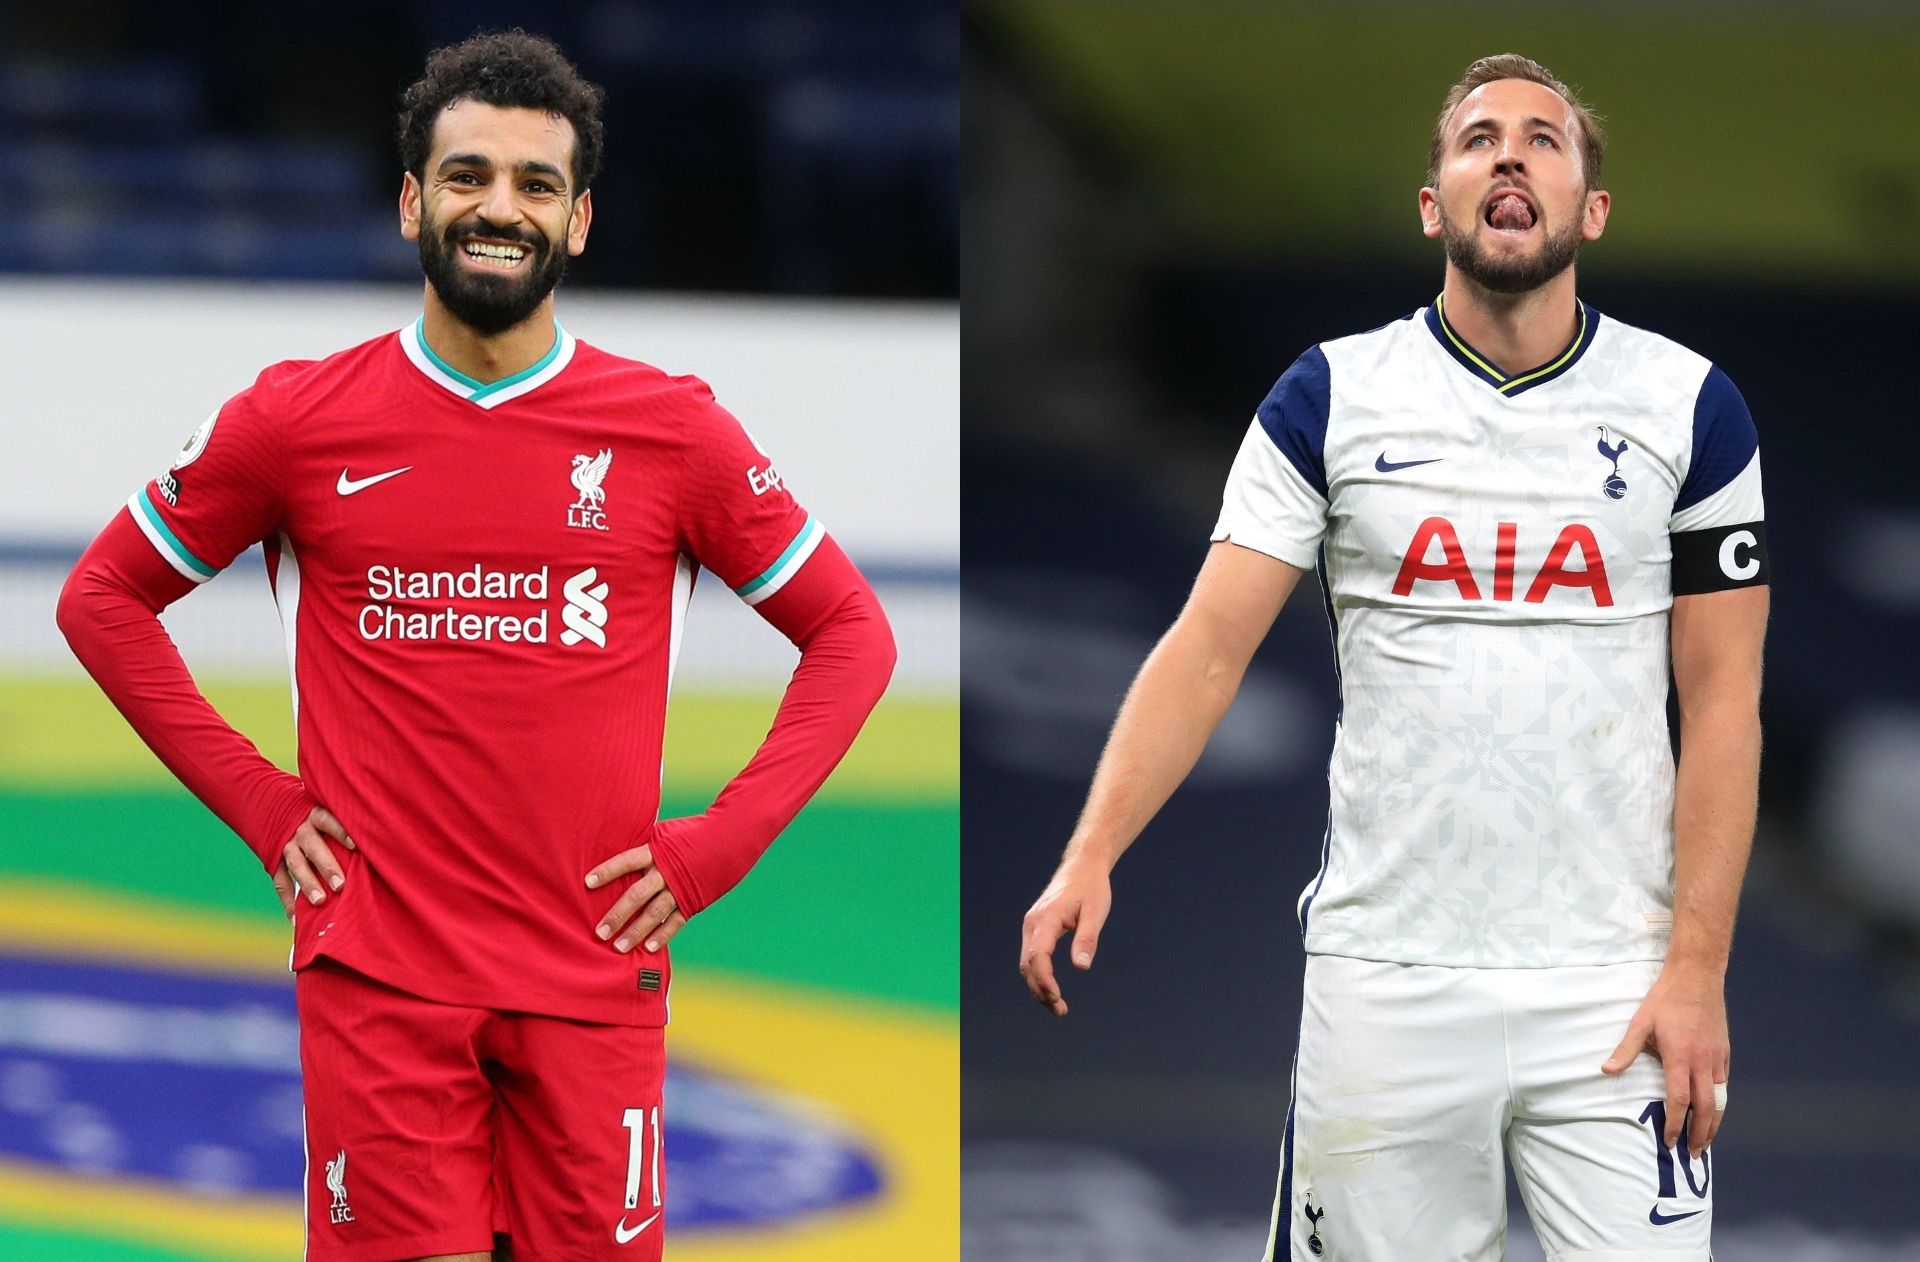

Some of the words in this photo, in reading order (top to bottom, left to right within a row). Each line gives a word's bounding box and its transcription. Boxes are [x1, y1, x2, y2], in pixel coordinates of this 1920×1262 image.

[1391, 516, 1614, 607] AIA
[1719, 530, 1760, 580] C
[367, 563, 548, 600] Standard
[358, 604, 548, 643] Chartered
[622, 1106, 662, 1209] 11
